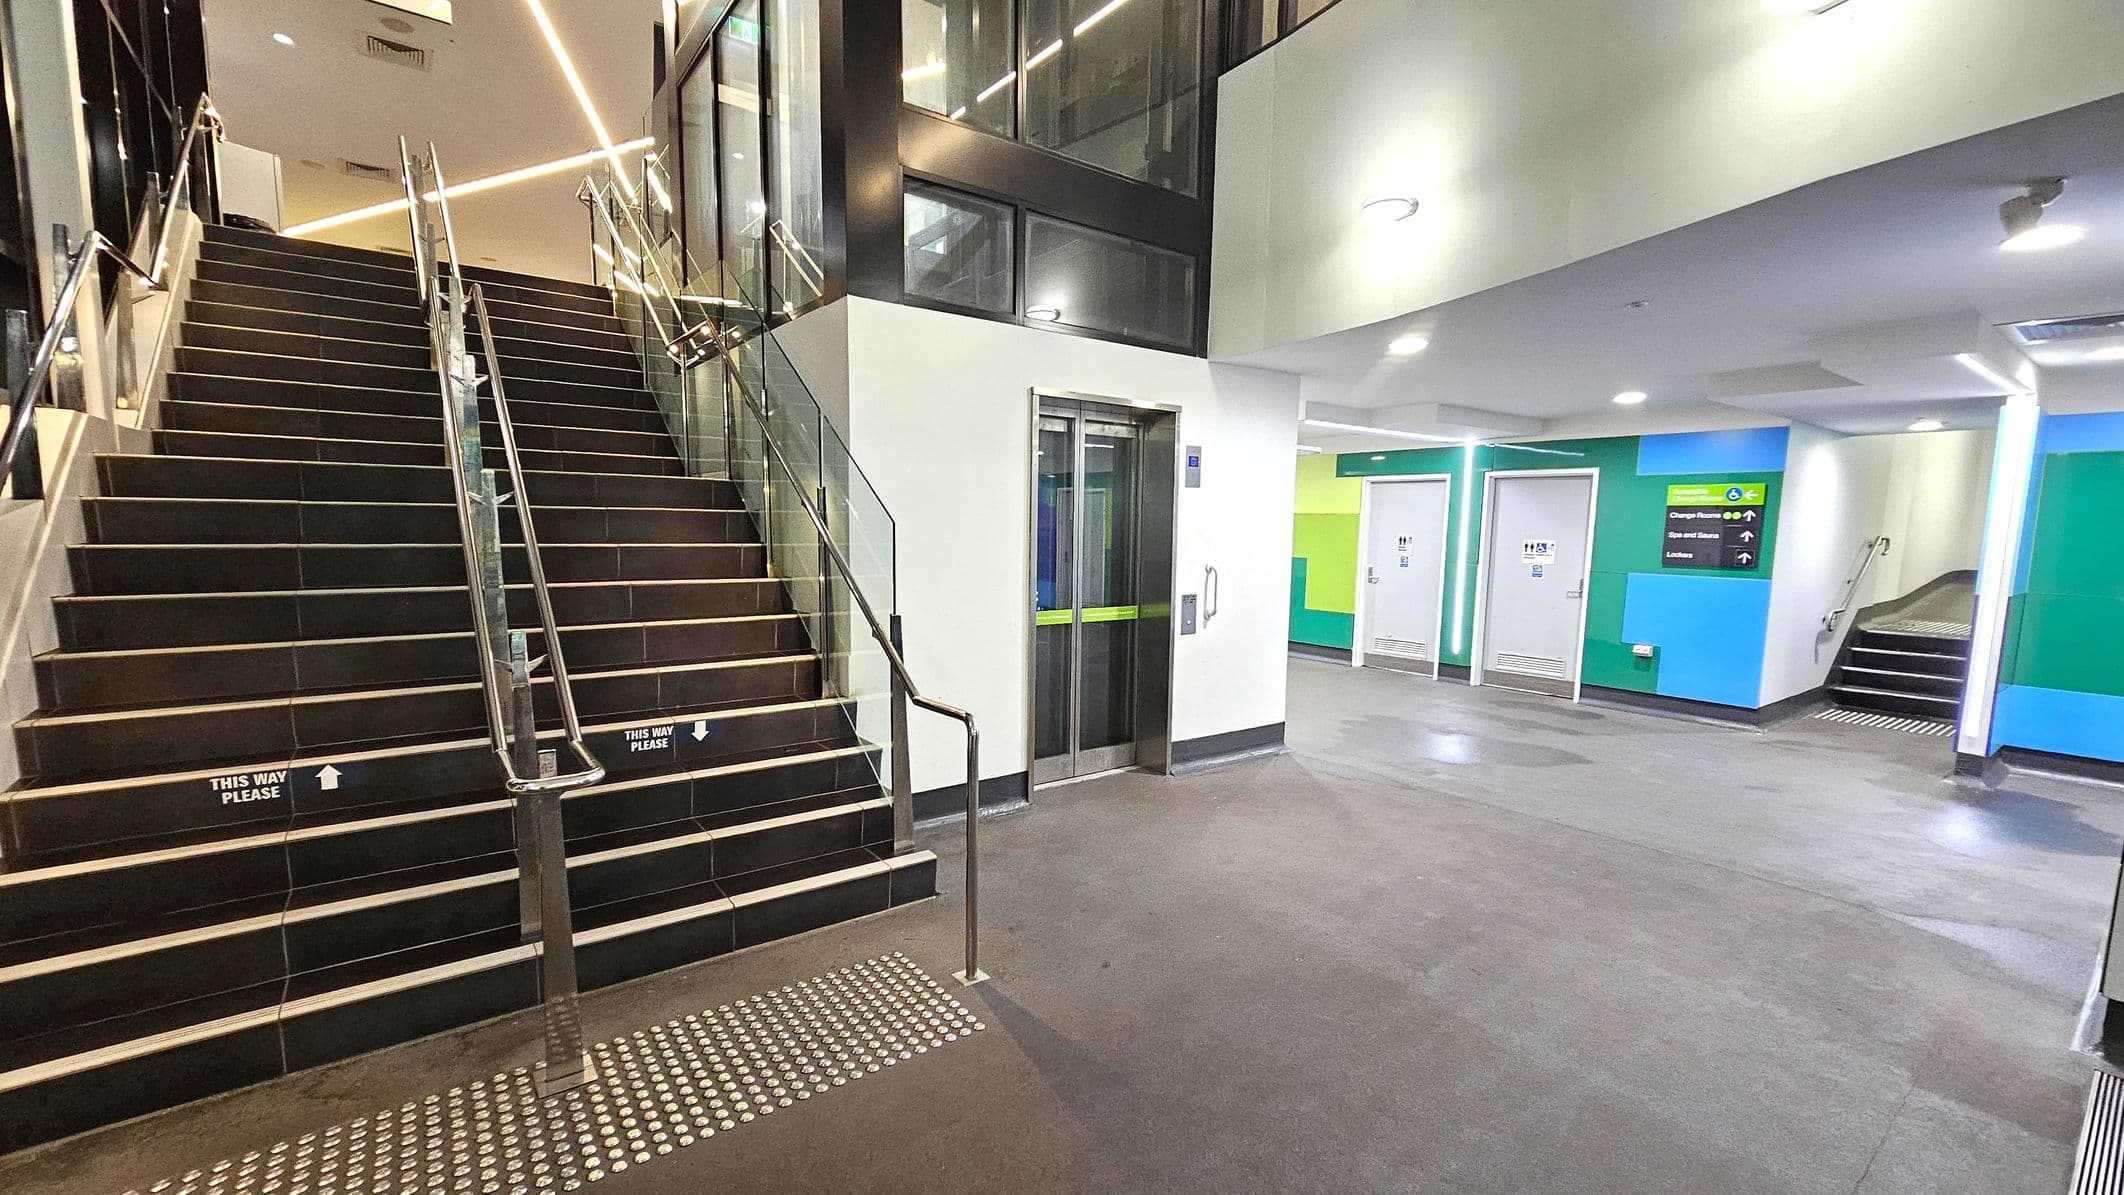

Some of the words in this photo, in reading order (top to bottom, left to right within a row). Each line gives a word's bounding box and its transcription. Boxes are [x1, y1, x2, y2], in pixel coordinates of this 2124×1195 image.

[1670, 511, 1696, 519] Change
[1697, 511, 1721, 519] Rooms
[1669, 532, 1683, 540] Spa
[1666, 551, 1693, 559] Lockers
[624, 728, 649, 741] THIS
[651, 725, 674, 738] WAY
[630, 738, 669, 752] PLEASE
[209, 775, 249, 791] THIS
[253, 770, 288, 786] WAY
[221, 786, 281, 805] PLEASE
